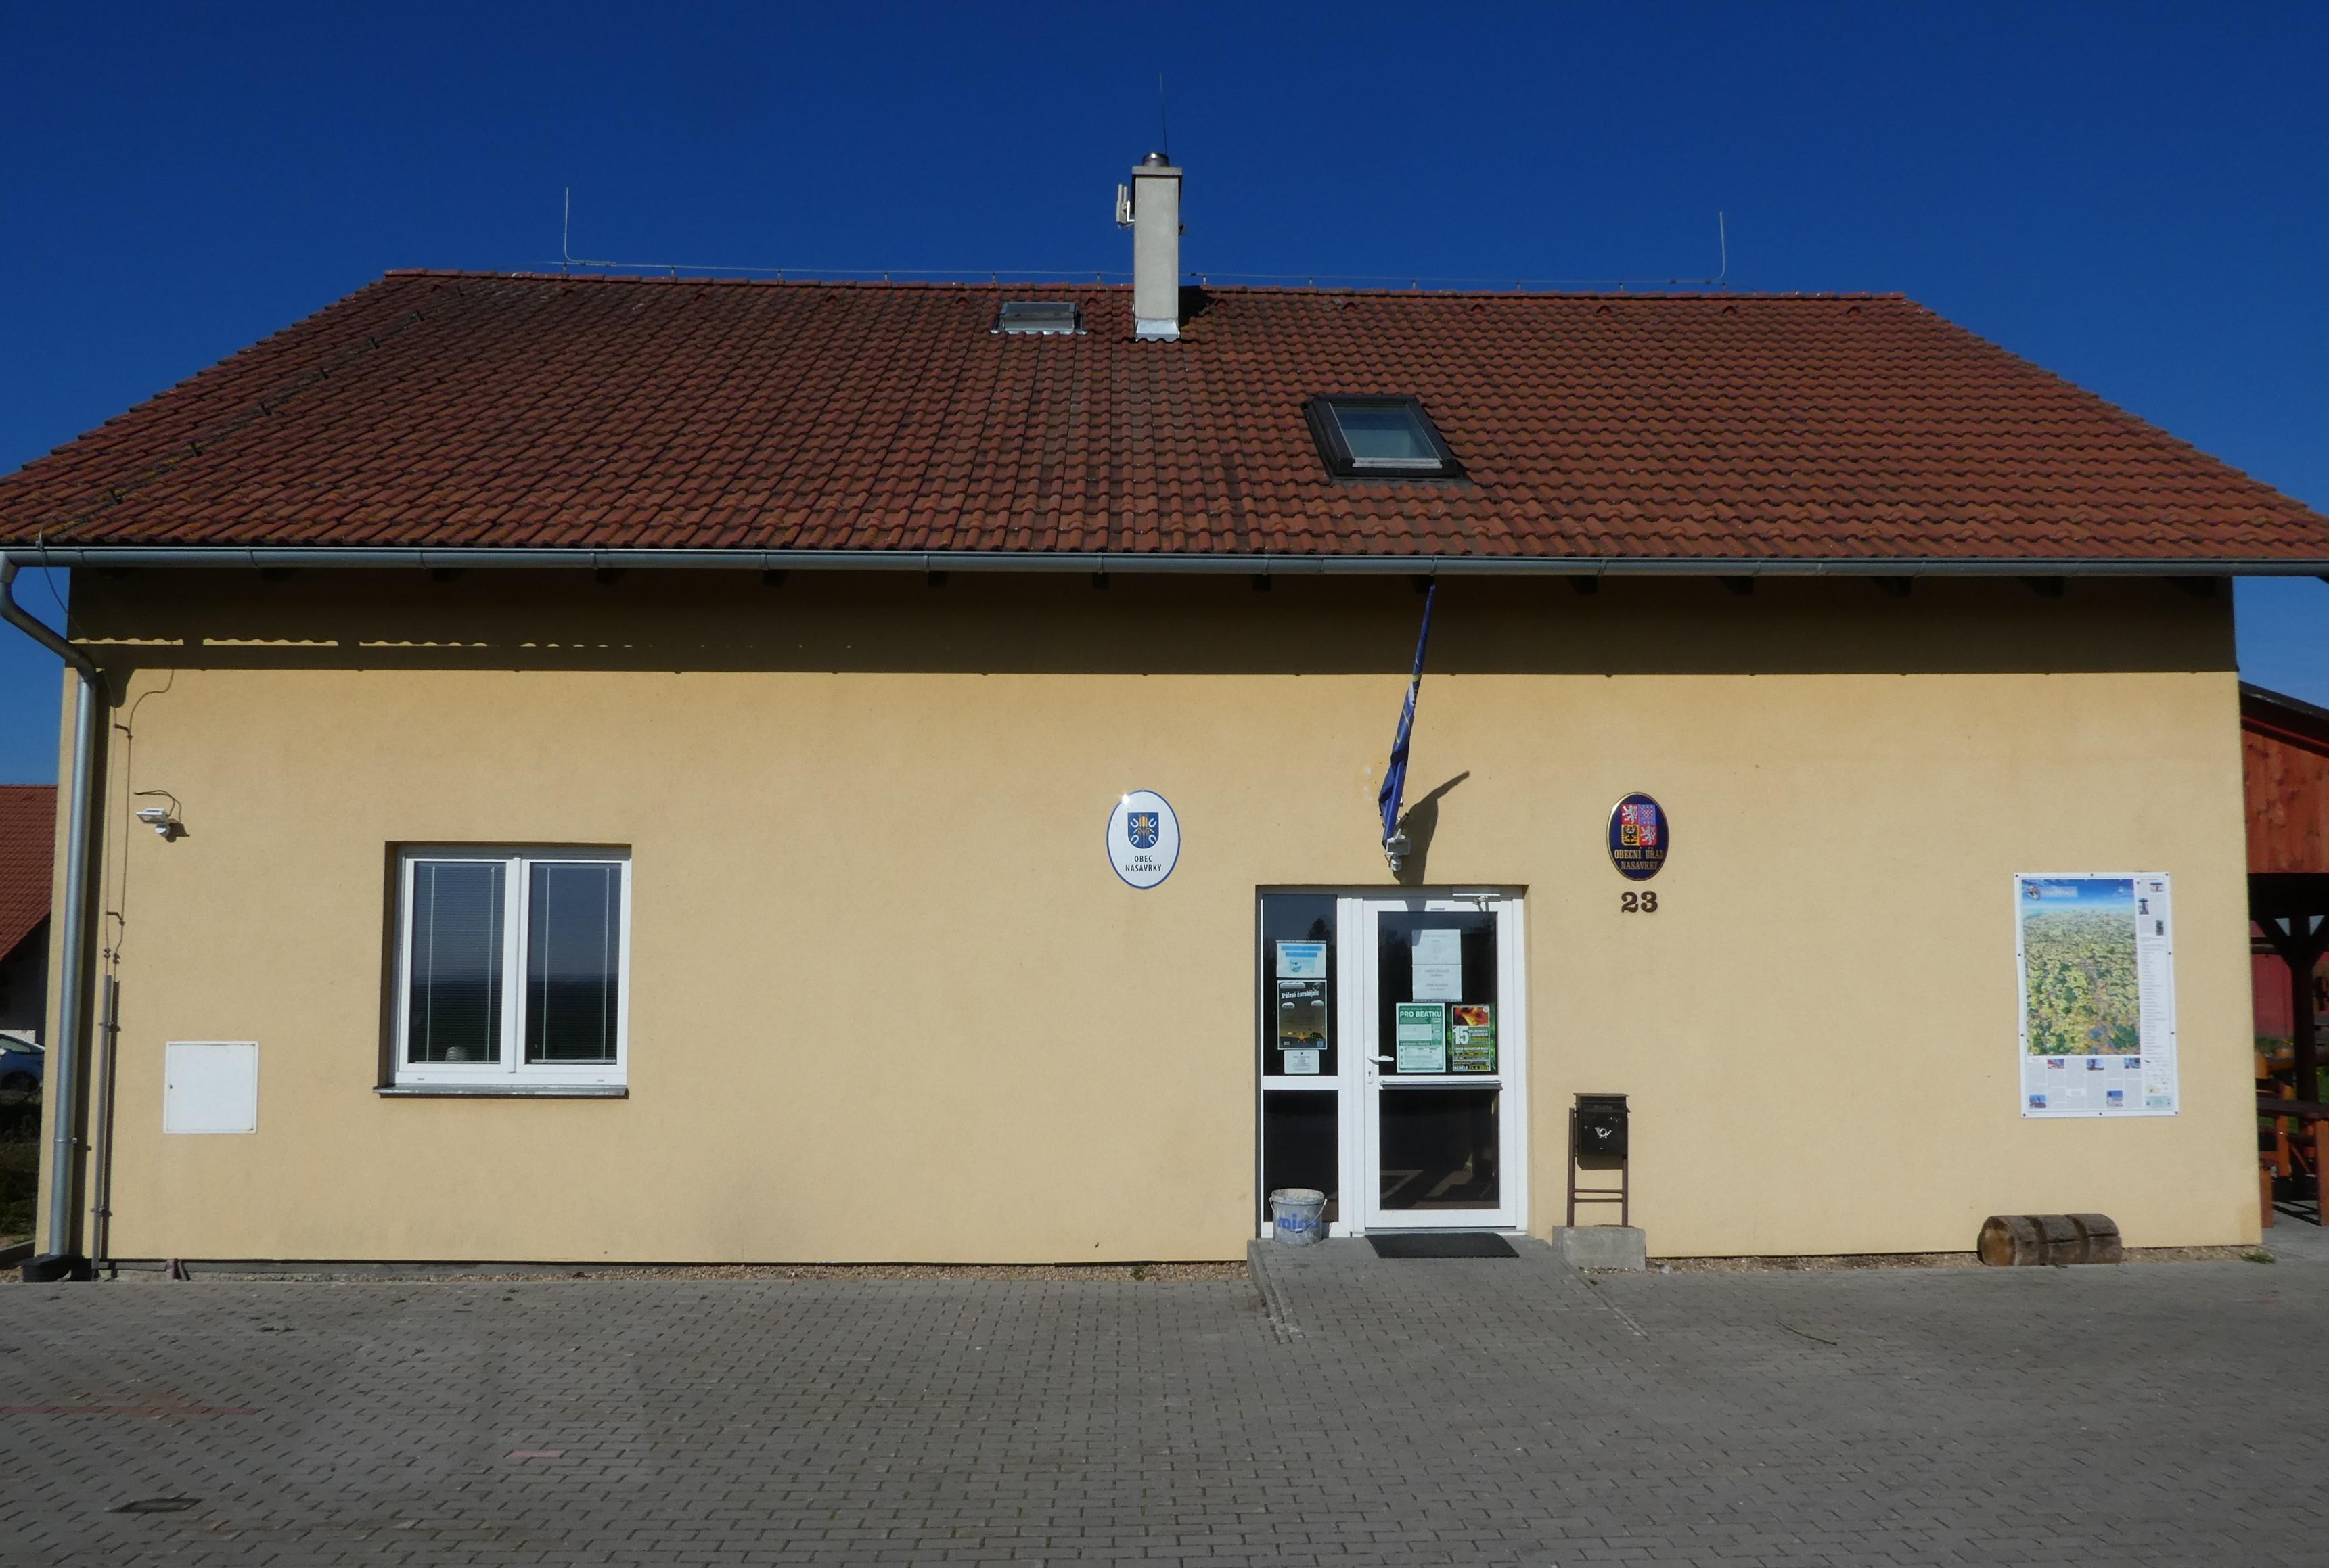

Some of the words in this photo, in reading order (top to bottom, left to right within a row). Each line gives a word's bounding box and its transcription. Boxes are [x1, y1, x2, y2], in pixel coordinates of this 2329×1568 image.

[1614, 847, 1642, 859] OBECNÍ
[1125, 864, 1162, 872] NASAVRKY
[1621, 890, 1658, 913] 23
[1453, 1026, 1469, 1044] 15
